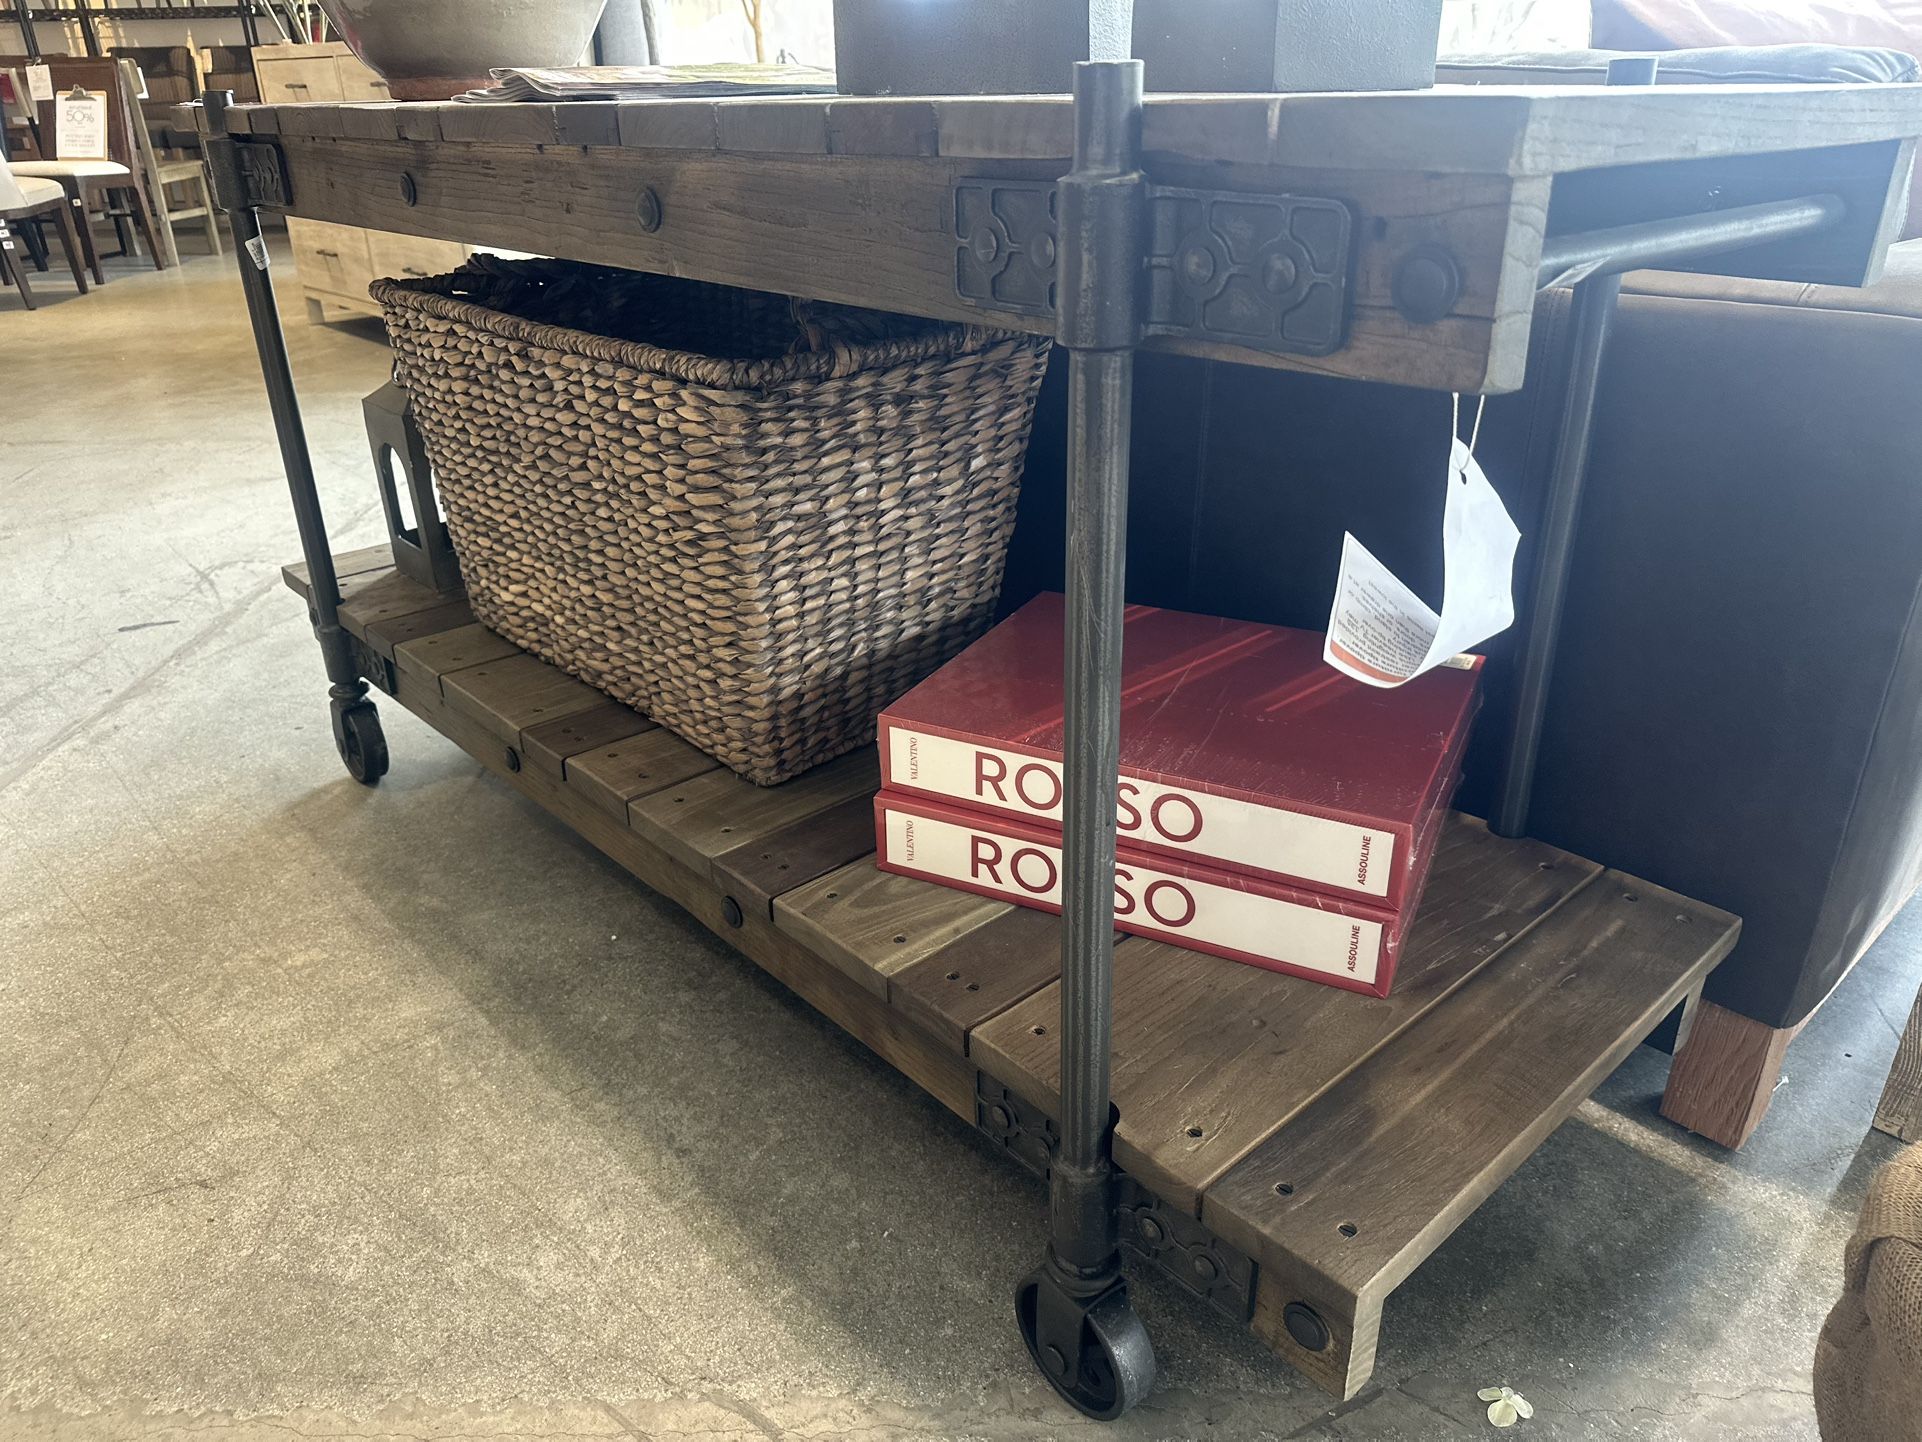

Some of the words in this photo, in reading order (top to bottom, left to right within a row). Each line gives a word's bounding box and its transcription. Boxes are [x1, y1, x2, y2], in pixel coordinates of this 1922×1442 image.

[66, 110, 95, 123] 50%
[910, 736, 918, 781] VALENTINO
[975, 750, 1204, 843] ROSO
[906, 819, 914, 862] VALENTINO
[1357, 834, 1372, 886] ASSOULINE
[970, 834, 1197, 928] ROSO
[1347, 924, 1361, 973] ASSOULINE
